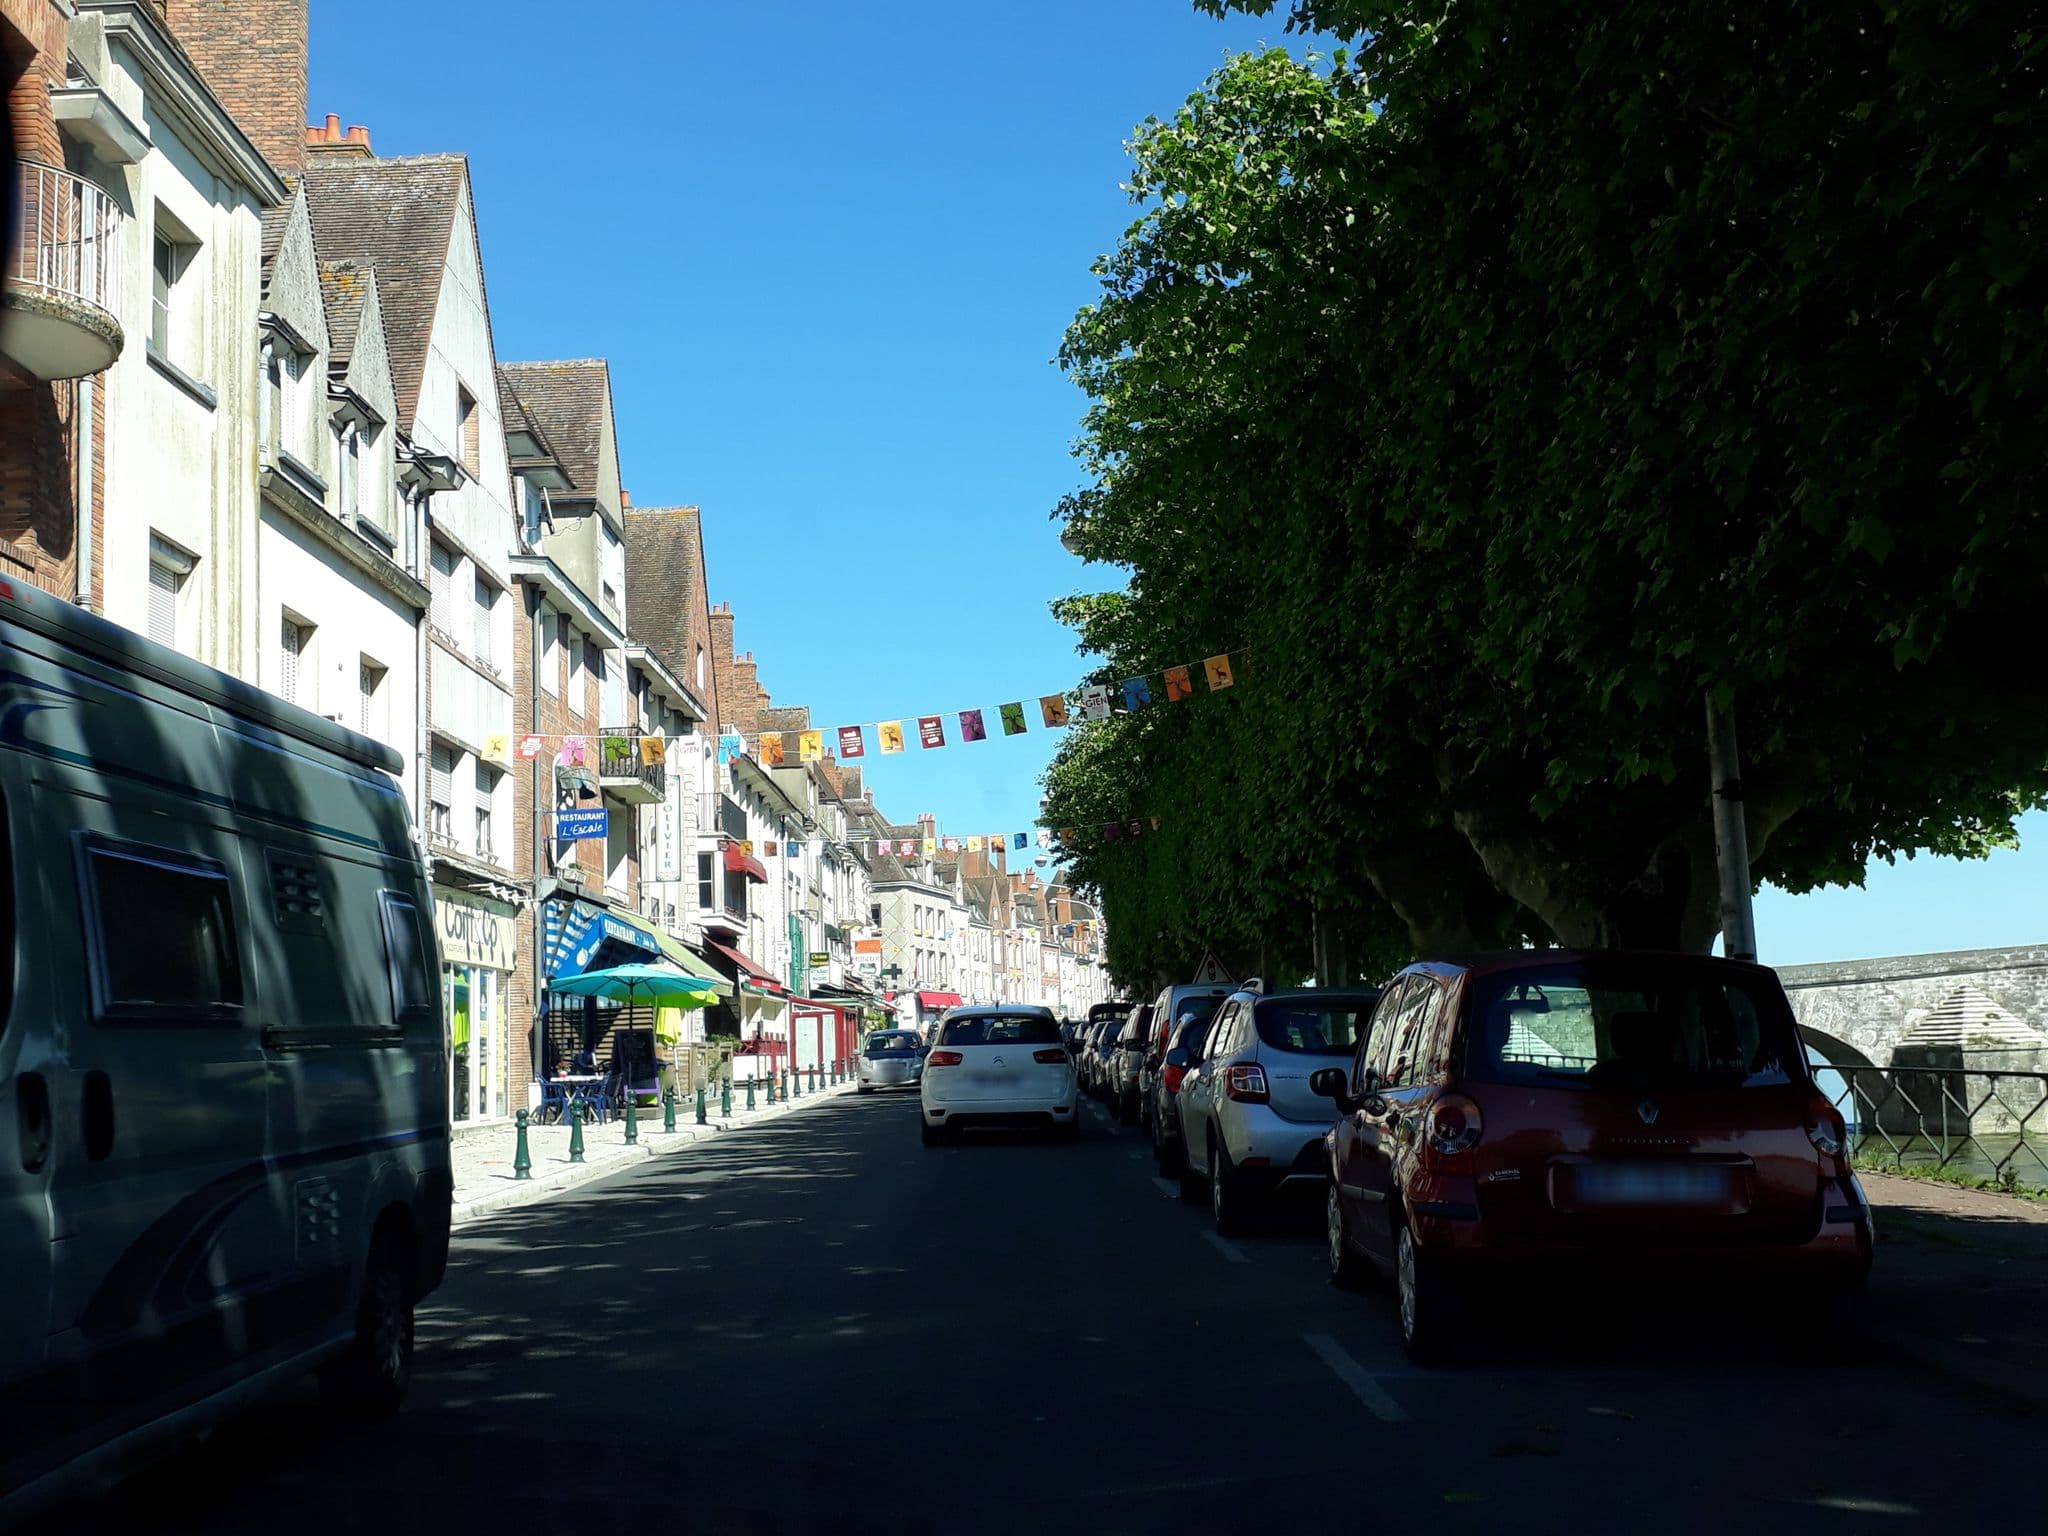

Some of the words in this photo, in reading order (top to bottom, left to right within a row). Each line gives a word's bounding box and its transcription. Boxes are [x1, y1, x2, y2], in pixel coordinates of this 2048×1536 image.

[1086, 697, 1107, 708] GIEN
[680, 746, 700, 754] GIEN
[560, 812, 605, 822] RESTAURANT
[562, 824, 603, 836] L'Escale
[663, 802, 673, 869] OLIVIER
